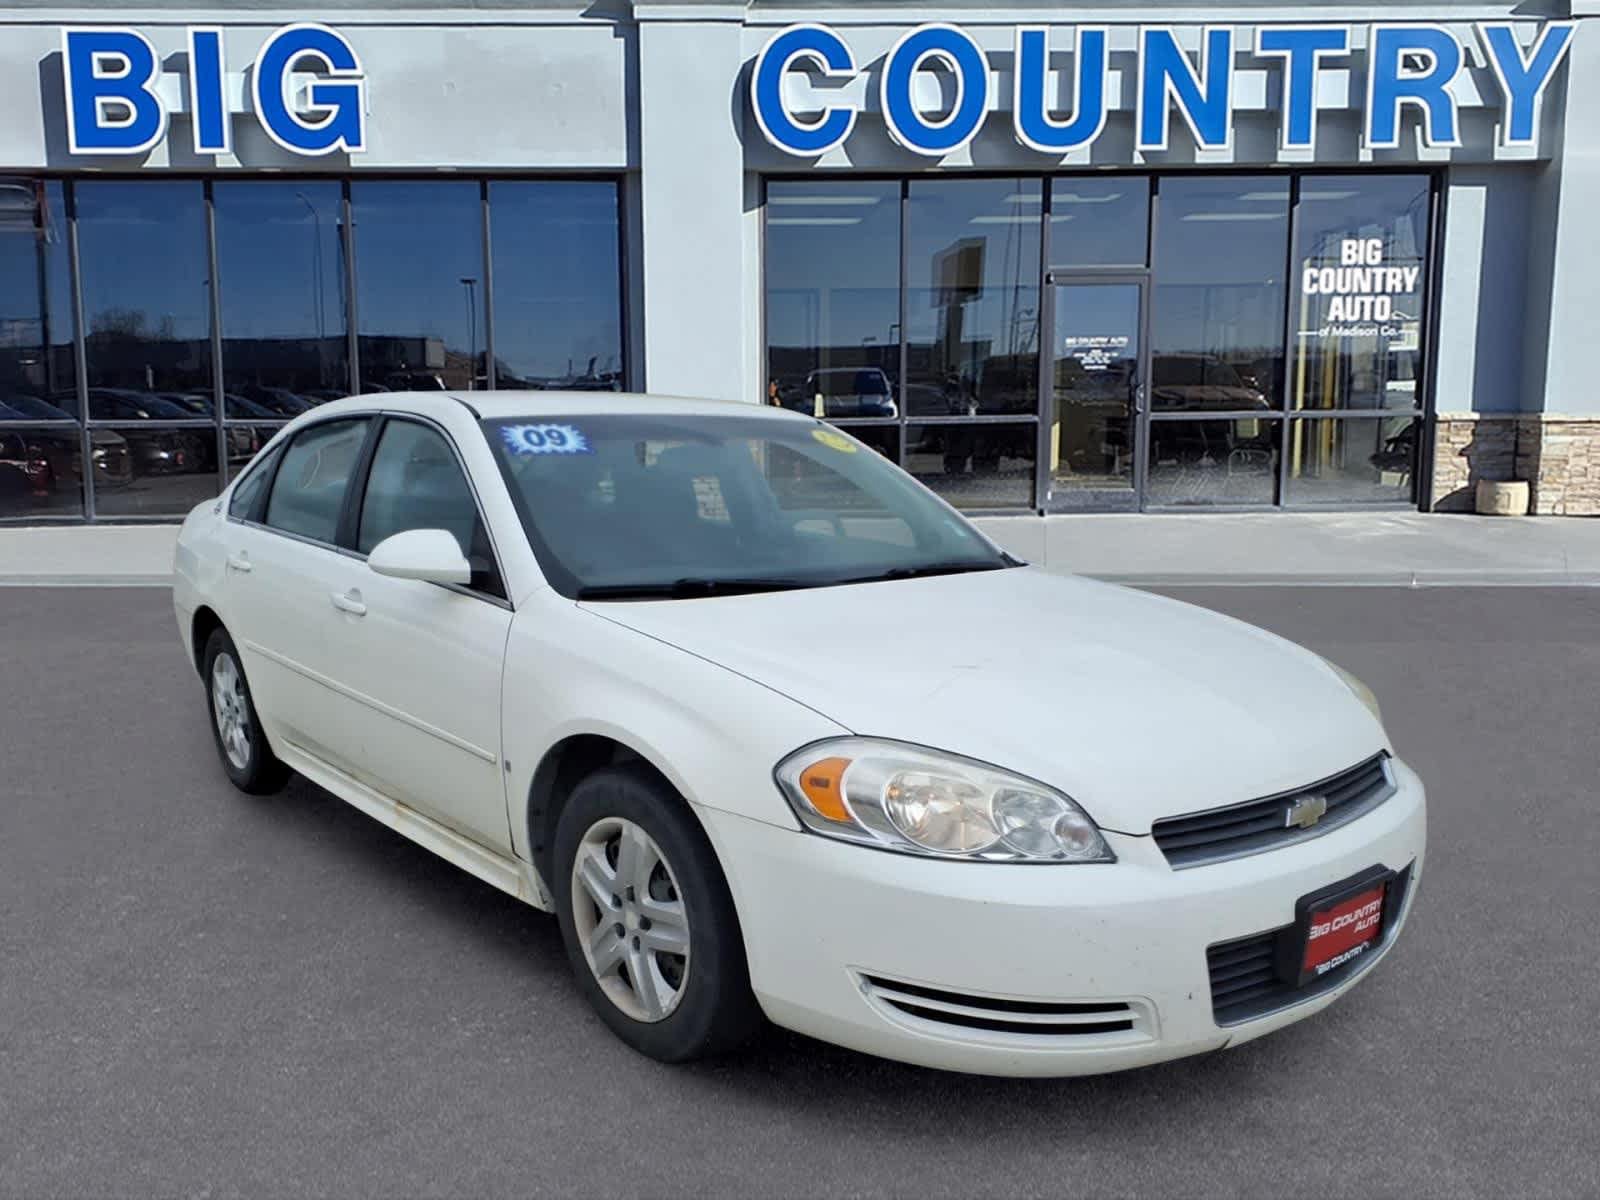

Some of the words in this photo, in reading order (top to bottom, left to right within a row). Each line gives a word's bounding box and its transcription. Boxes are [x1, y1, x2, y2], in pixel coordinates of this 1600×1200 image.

[61, 22, 367, 157] BIG
[750, 21, 1575, 157] COUNTRY
[1341, 239, 1383, 265] BIG
[1303, 266, 1419, 294] COUNTRY
[1328, 295, 1392, 322] AUTO
[1319, 326, 1331, 337] of
[1331, 326, 1378, 337] Madison
[1380, 325, 1398, 337] Co.
[523, 428, 568, 448] 09
[1309, 922, 1331, 940] BIG
[1331, 897, 1383, 932] COUNTRY
[1354, 912, 1381, 933] AUTO
